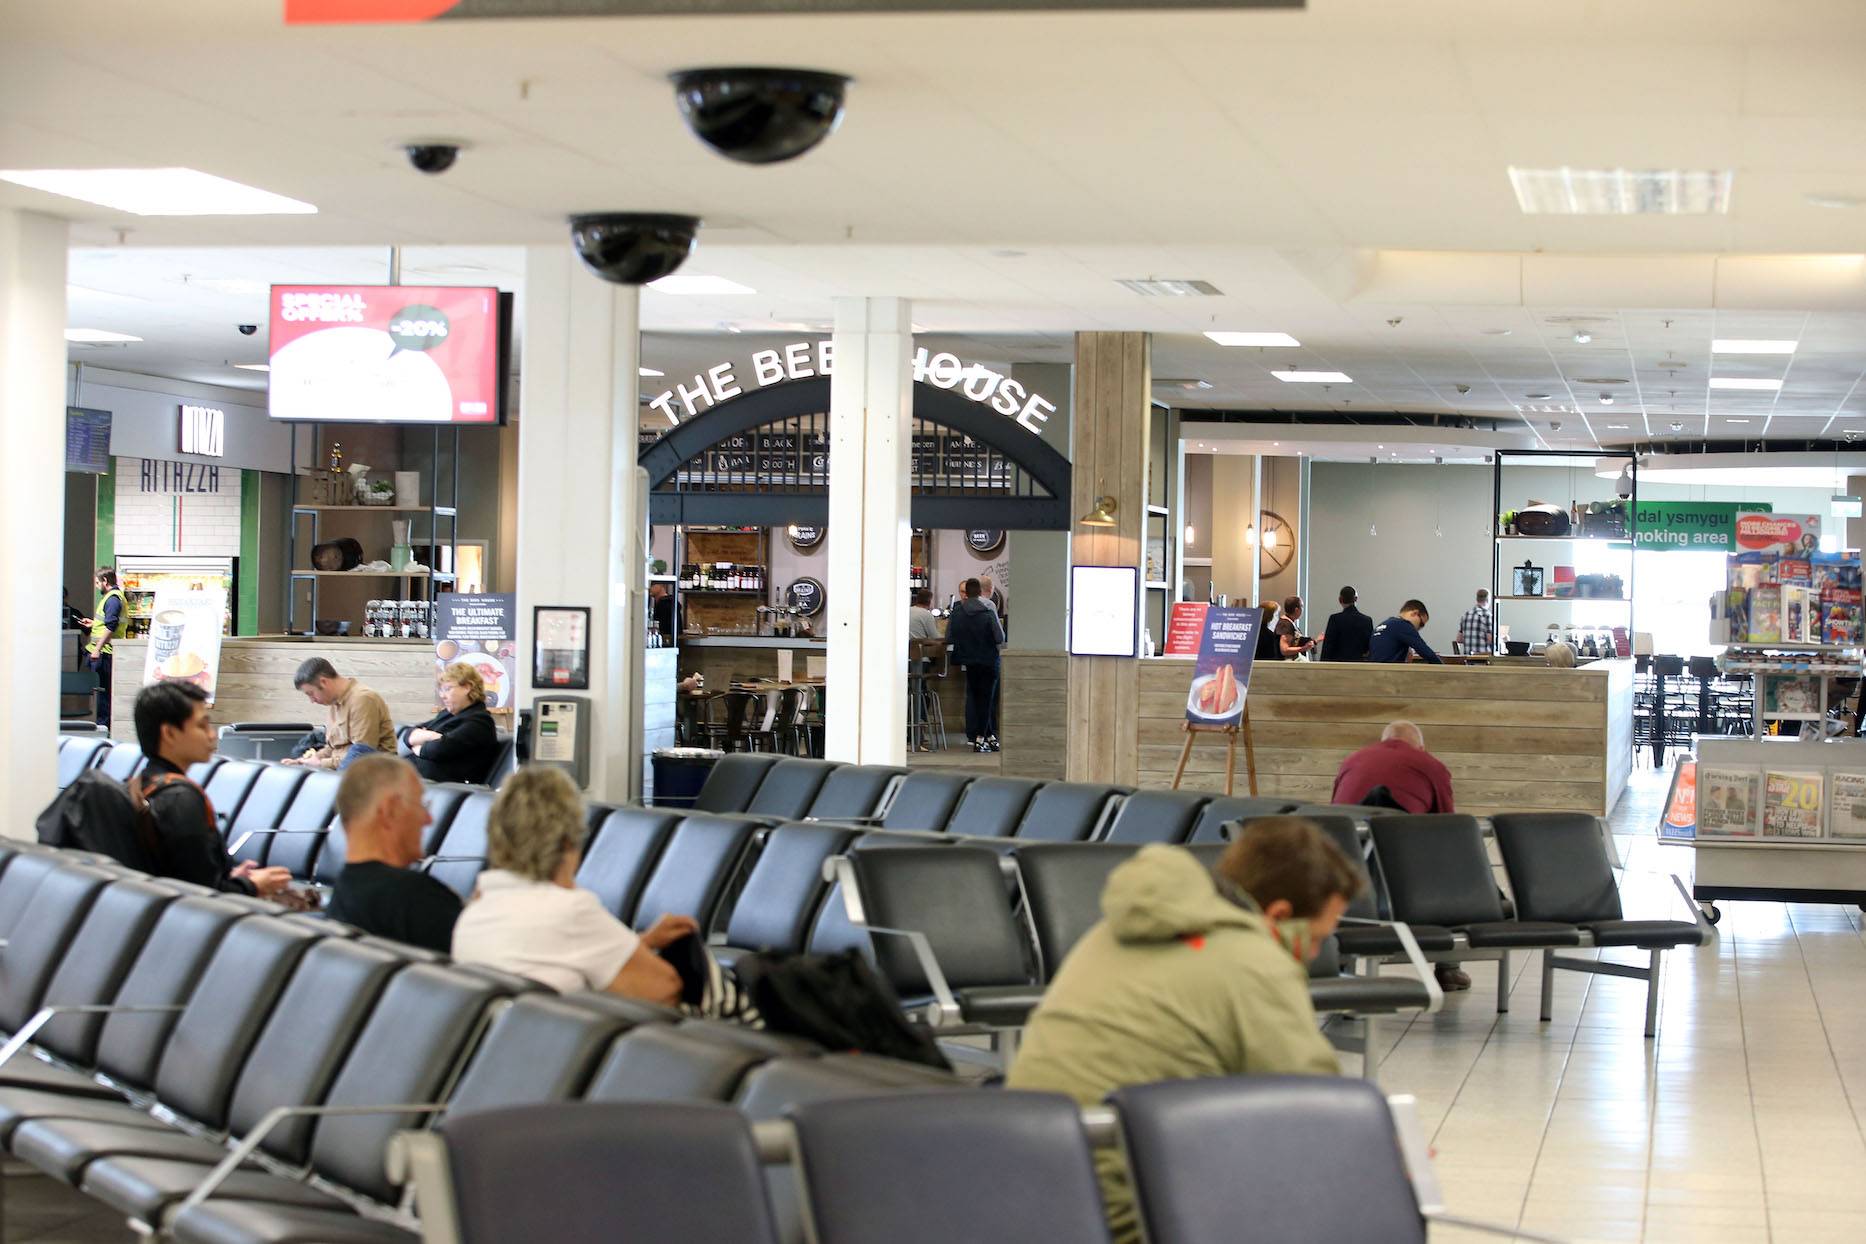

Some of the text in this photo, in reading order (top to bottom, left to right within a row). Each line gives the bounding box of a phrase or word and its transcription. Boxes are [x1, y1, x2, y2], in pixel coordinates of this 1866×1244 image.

[649, 362, 742, 426] THE
[752, 341, 832, 387] BEE
[1666, 512, 1728, 526] ysmygu
[1693, 532, 1728, 544] area
[451, 607, 504, 617] THE ULTIMATE
[456, 616, 499, 625] BREAKFAST
[1222, 623, 1252, 632] BREAKFAST
[1212, 631, 1247, 640] SANDWICHES
